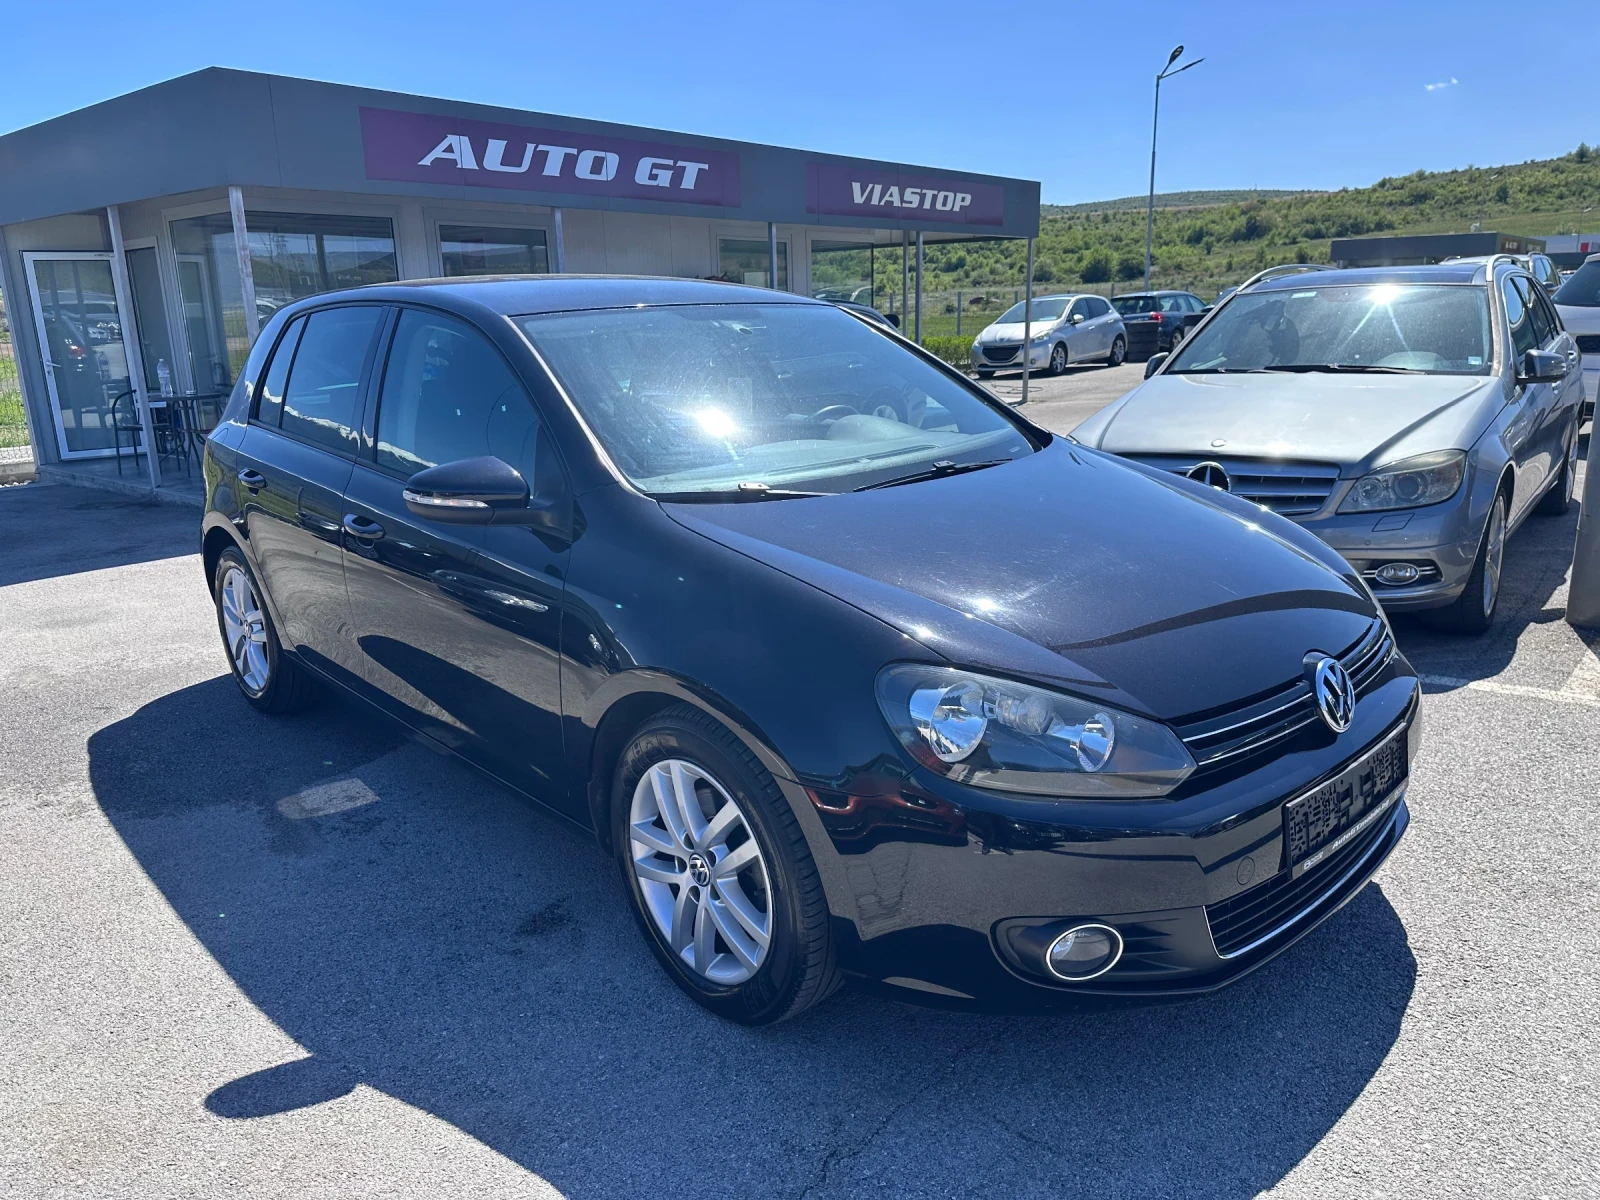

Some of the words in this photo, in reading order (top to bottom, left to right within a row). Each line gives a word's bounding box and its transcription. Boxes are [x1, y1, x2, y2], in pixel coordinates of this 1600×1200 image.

[417, 134, 619, 182] AUTO
[634, 156, 709, 189] GT
[851, 181, 972, 212] VIASTOP
